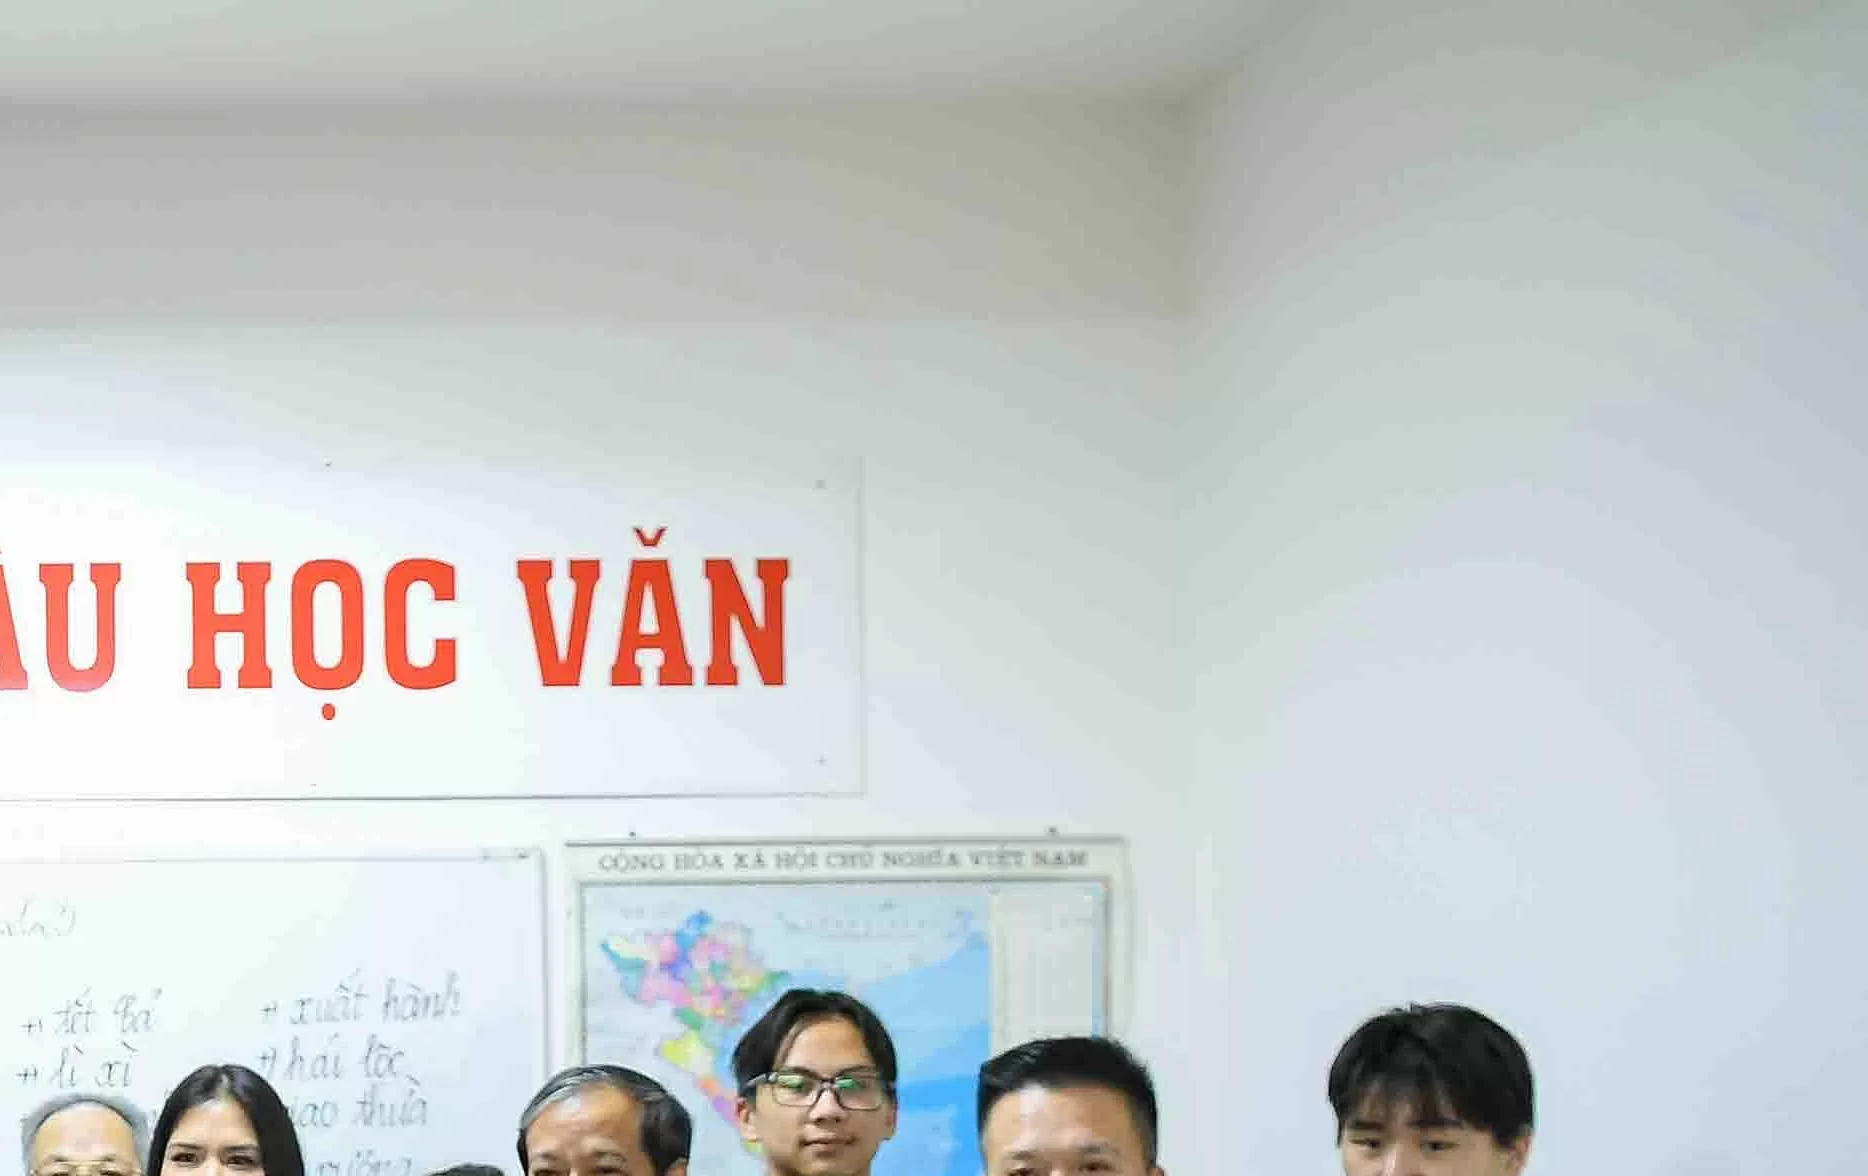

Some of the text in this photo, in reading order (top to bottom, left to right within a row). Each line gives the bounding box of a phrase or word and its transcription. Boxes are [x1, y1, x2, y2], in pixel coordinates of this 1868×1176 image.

[185, 558, 458, 720] HỌC
[516, 528, 790, 688] VĂN
[597, 850, 665, 874] CỘNG
[1034, 851, 1089, 867] NAM
[383, 971, 461, 1023] hành
